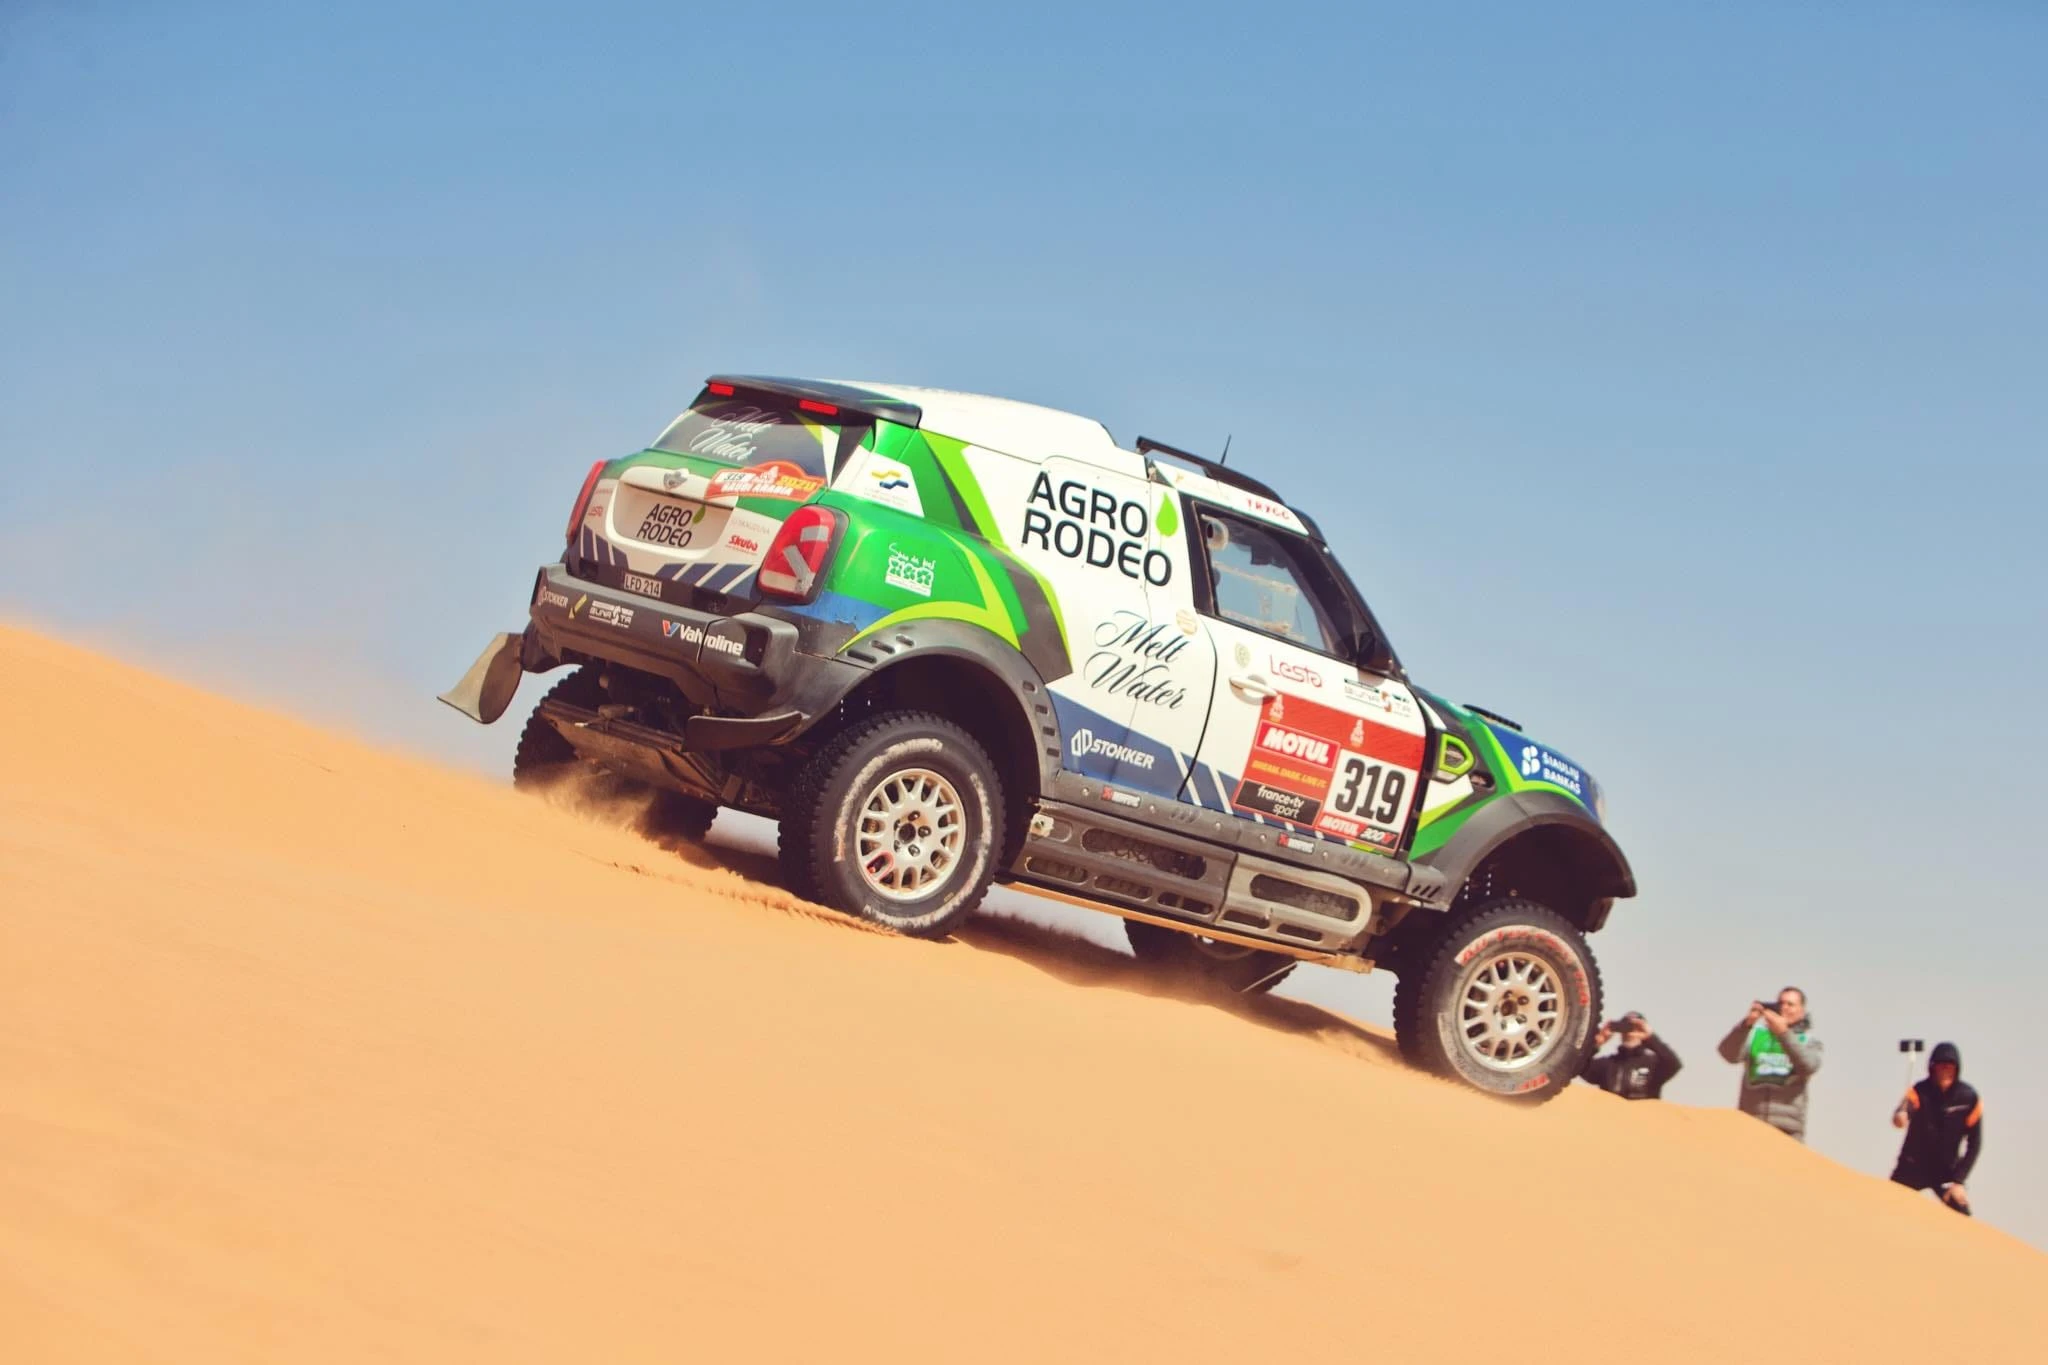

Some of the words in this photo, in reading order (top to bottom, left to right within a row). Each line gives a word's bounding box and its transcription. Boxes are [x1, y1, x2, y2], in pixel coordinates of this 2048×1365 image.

[646, 503, 693, 527] AGRO
[1027, 471, 1148, 538] AGRO
[637, 521, 693, 548] RODEO
[1022, 509, 1173, 588] RODEO
[624, 575, 642, 592] LFD
[643, 580, 661, 597] 214
[679, 624, 744, 656] Valvoline
[1094, 610, 1190, 663] Melt
[1083, 651, 1187, 709] Water
[1091, 739, 1155, 770] STOKKER
[1262, 727, 1330, 764] MOTUL
[1334, 757, 1406, 825] 319
[1273, 803, 1299, 818] sport
[1319, 814, 1361, 838] MOTUL
